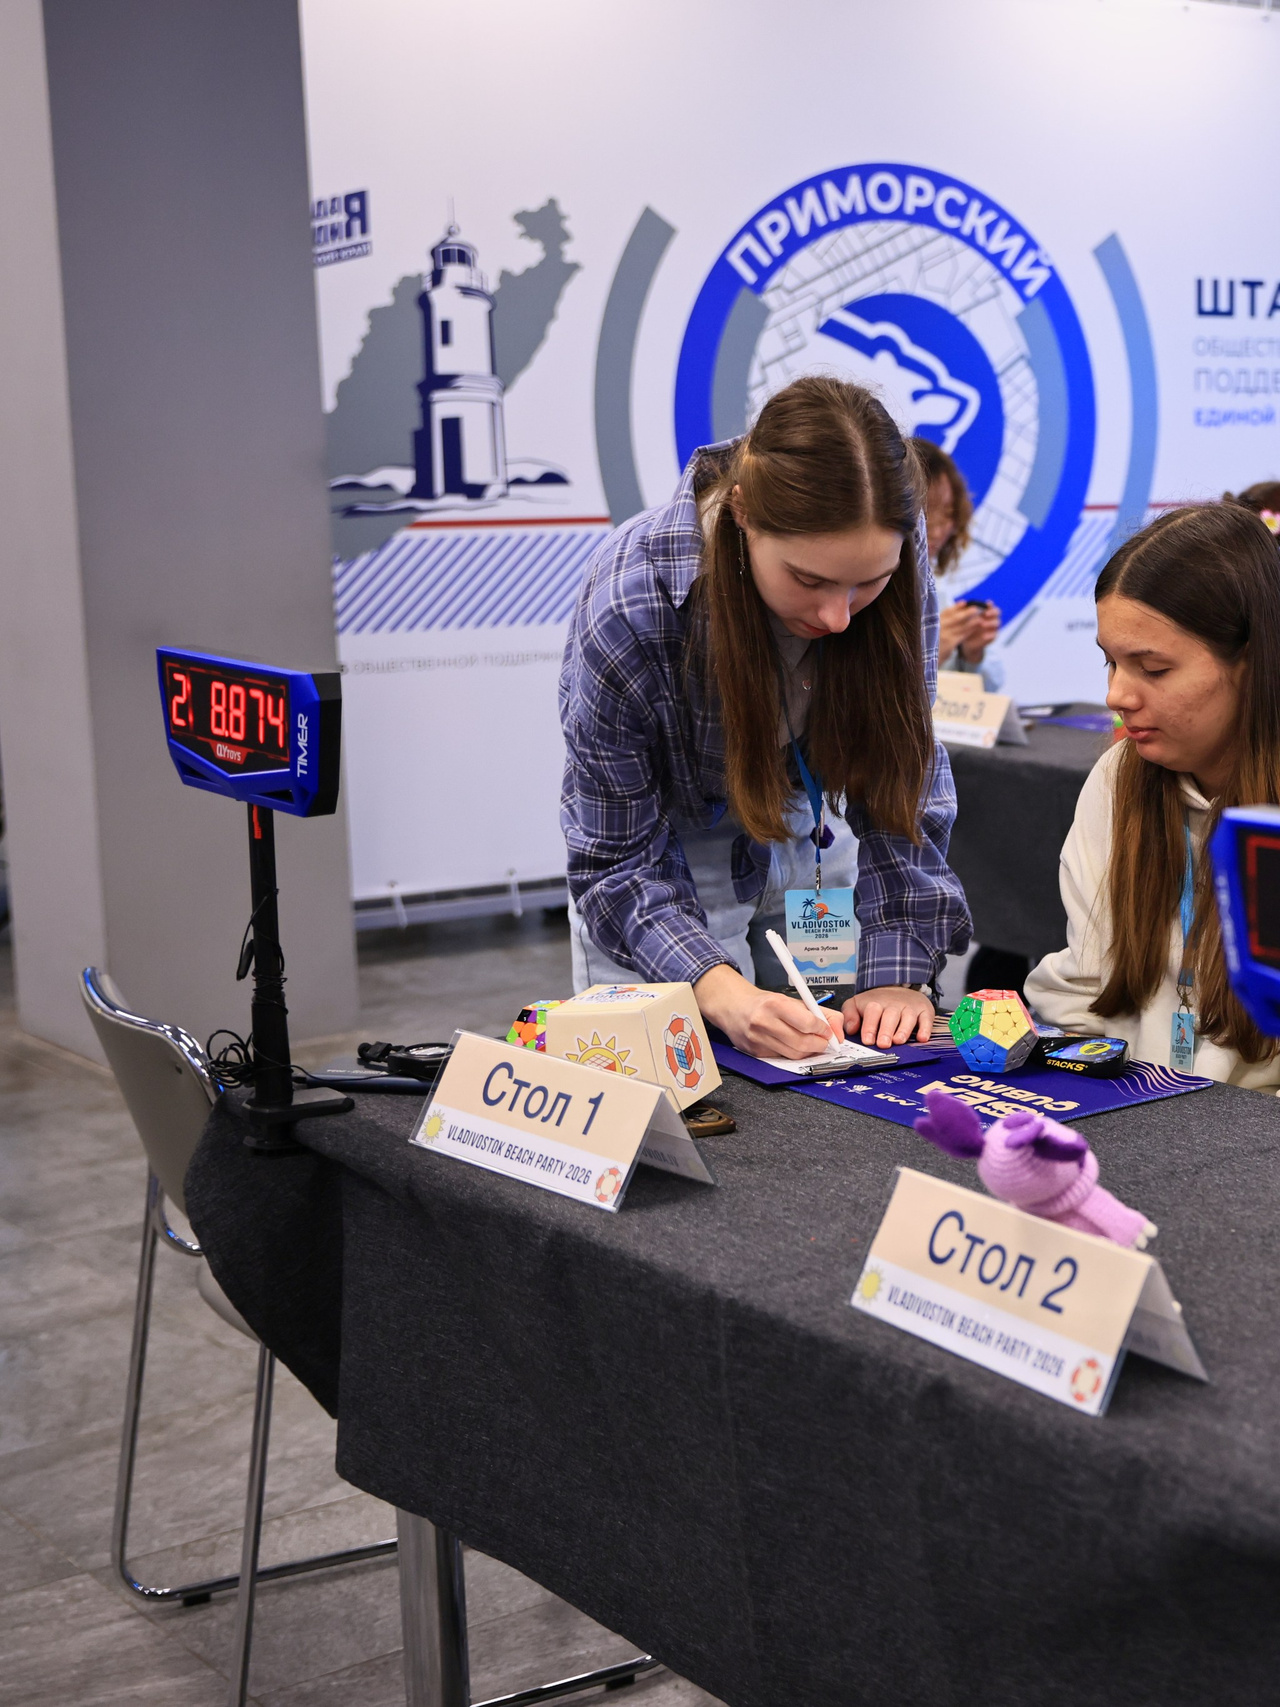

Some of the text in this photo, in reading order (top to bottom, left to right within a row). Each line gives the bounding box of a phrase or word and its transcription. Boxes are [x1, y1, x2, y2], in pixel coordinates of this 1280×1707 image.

[726, 172, 1053, 297] ПРИМОРСКИЙ
[297, 713, 308, 777] TIMER
[791, 919, 851, 929] VLADIVOSTOK
[805, 975, 839, 984] УЧАСТНИК
[950, 1074, 1080, 1112] CUBING
[1046, 1058, 1085, 1072] STACKS
[482, 1061, 605, 1136] Стол 1
[447, 1124, 592, 1186] VLADIVOSTOK BEACH PARTY 2026
[928, 1210, 1079, 1315] Стол 2
[887, 1284, 1066, 1377] VLADIVOSTOK BEACH PARTY 2026
